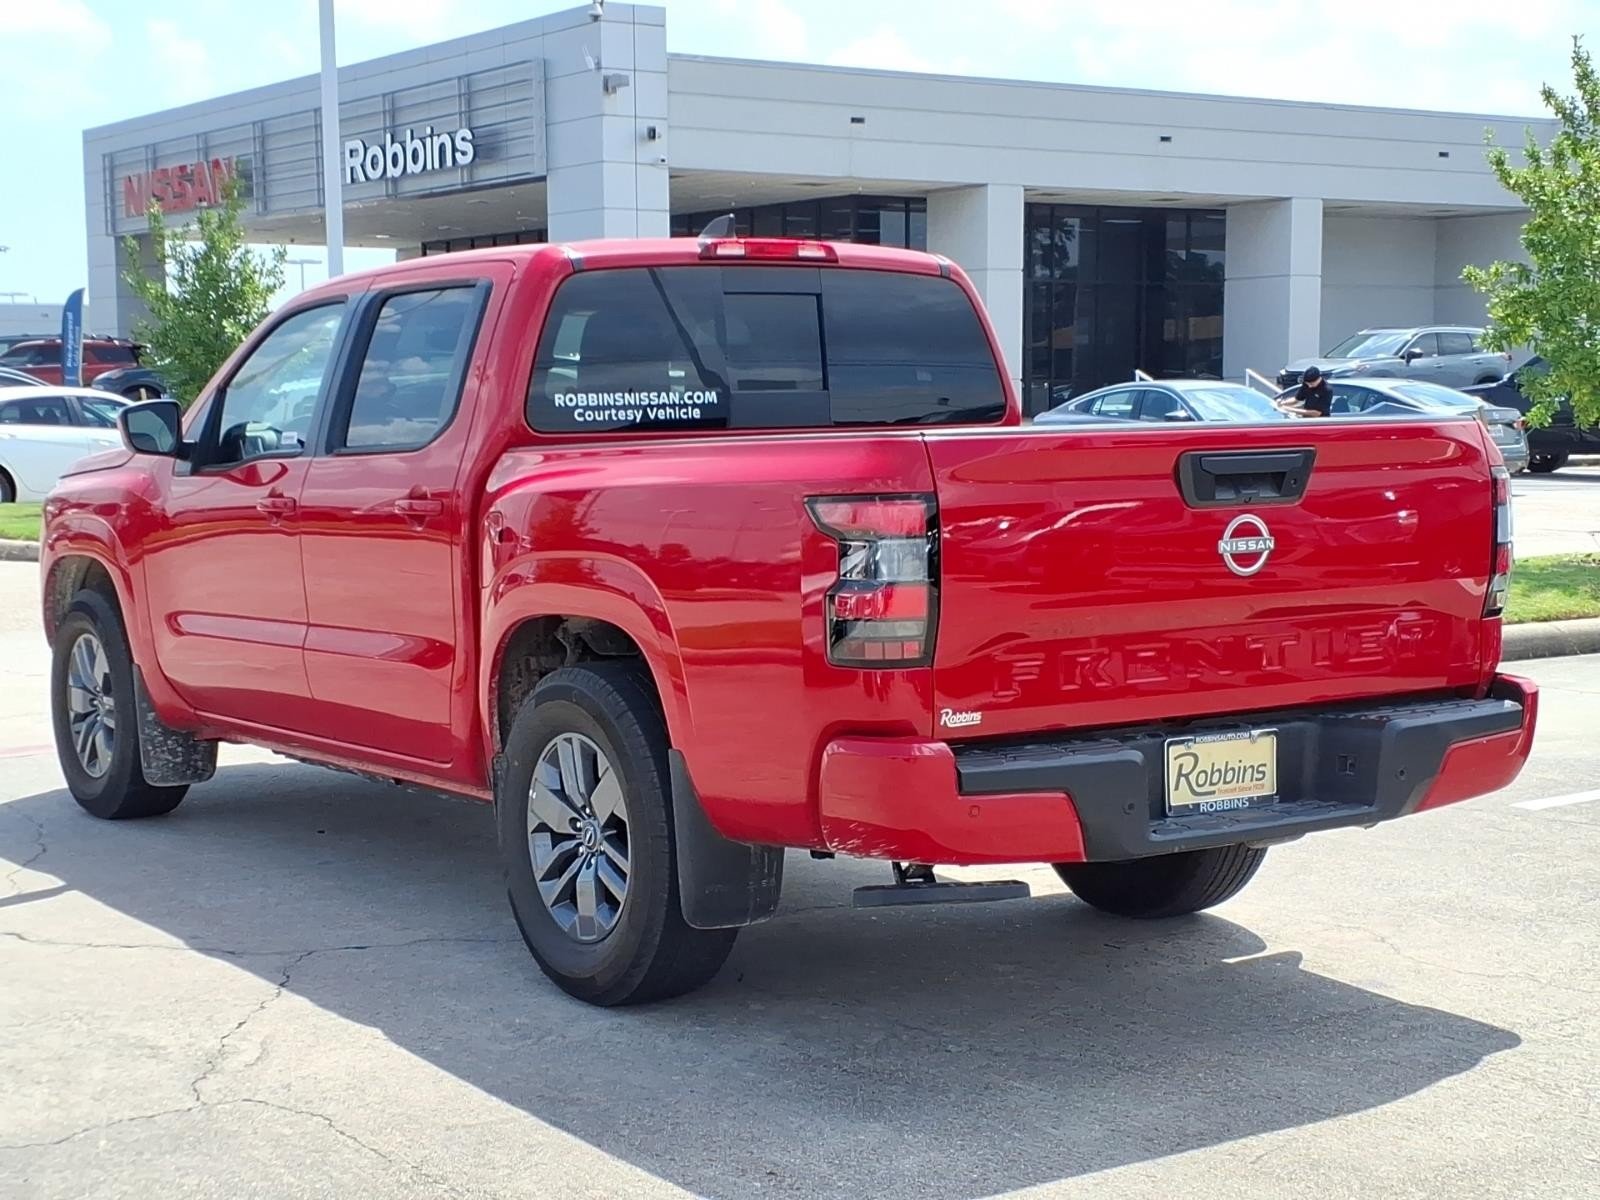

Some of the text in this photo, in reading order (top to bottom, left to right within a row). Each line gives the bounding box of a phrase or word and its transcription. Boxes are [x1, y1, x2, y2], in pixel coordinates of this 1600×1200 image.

[344, 126, 475, 184] Robbins
[124, 156, 237, 217] NISSAN
[554, 391, 718, 407] ROBBINSNISSAN.COM
[573, 406, 701, 423] Courtesy Vehicle
[1220, 540, 1273, 552] NISSAN
[940, 708, 982, 727] Robbins
[1195, 731, 1250, 744] ROBBINSAUTO.COM
[1173, 752, 1267, 797] Robbins
[1200, 797, 1250, 813] ROBBINS
